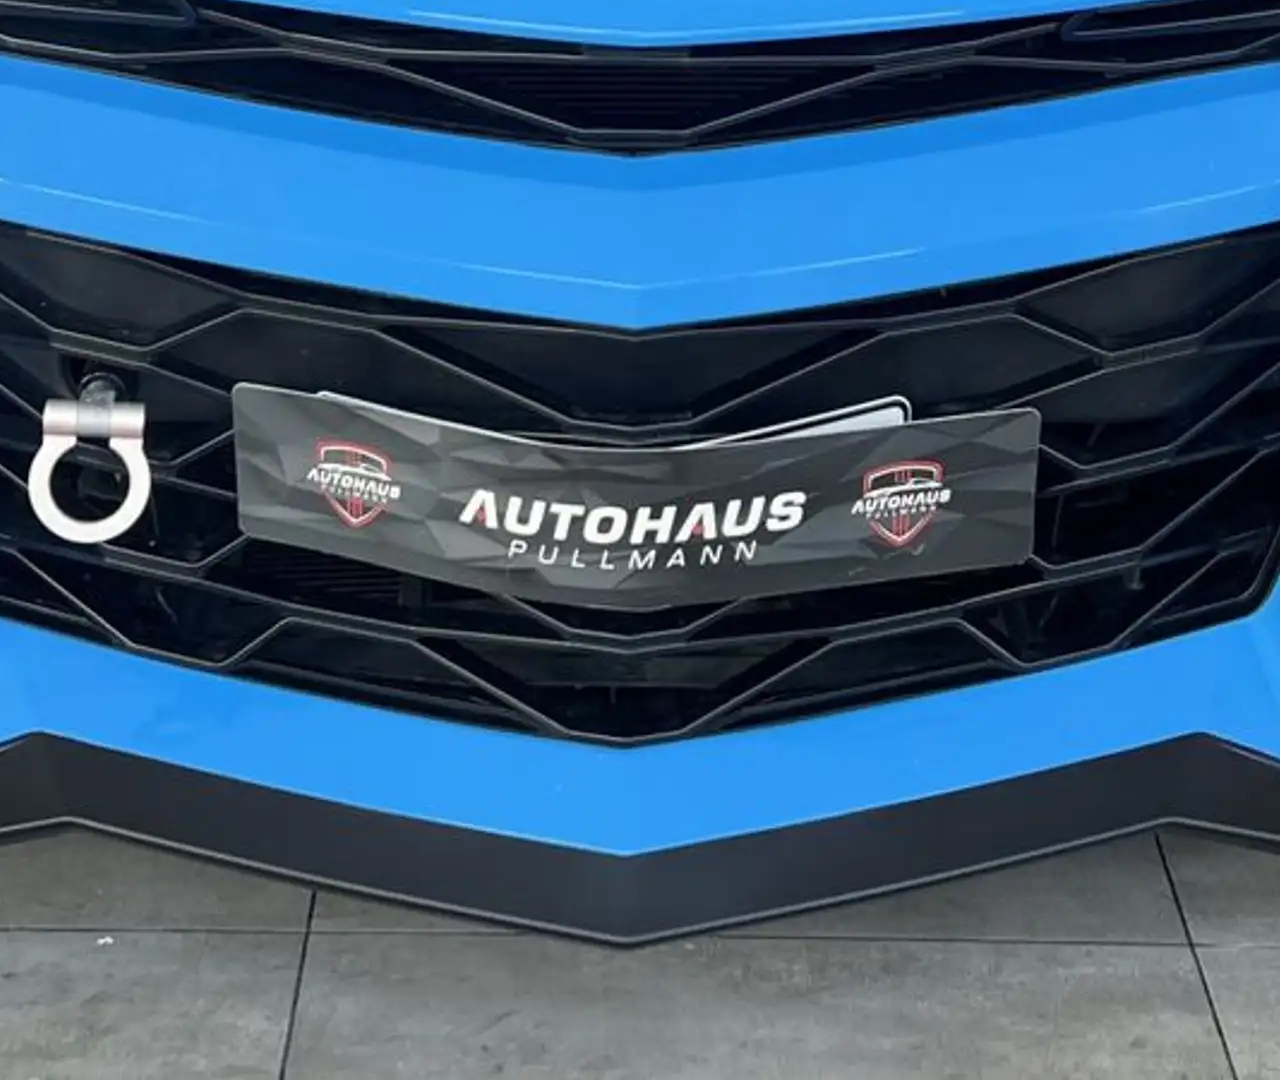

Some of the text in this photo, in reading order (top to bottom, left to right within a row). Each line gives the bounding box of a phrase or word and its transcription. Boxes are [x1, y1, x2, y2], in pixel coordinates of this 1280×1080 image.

[306, 467, 401, 500] AUTOHAUS
[458, 488, 807, 545] AUTOHAUS
[851, 489, 952, 516] AUTOHAUS
[507, 539, 758, 570] PULLMANN
